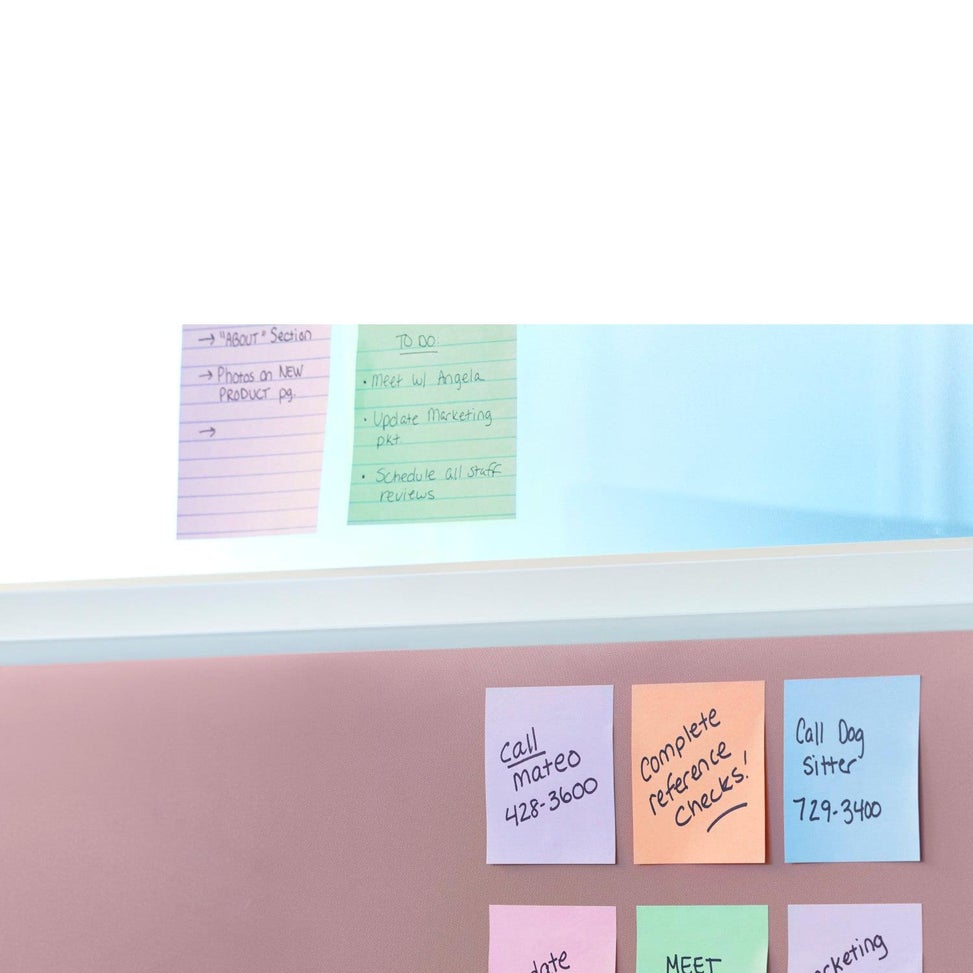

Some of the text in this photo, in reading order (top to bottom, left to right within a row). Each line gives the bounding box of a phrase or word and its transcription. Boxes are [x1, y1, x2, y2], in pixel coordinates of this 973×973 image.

[270, 326, 312, 344] Section
[395, 333, 413, 350] TO
[217, 366, 255, 384] Photos
[279, 364, 304, 378] NEW
[437, 368, 486, 391] Angela
[219, 386, 271, 402] PRODUCT
[373, 410, 419, 431] Update
[375, 467, 437, 484] Schedule
[445, 464, 462, 480] all
[379, 487, 436, 503] reviews
[795, 716, 865, 759] Call Dog
[648, 741, 732, 816] reference
[505, 777, 598, 827] 428-3600
[792, 796, 882, 825] 729-3400
